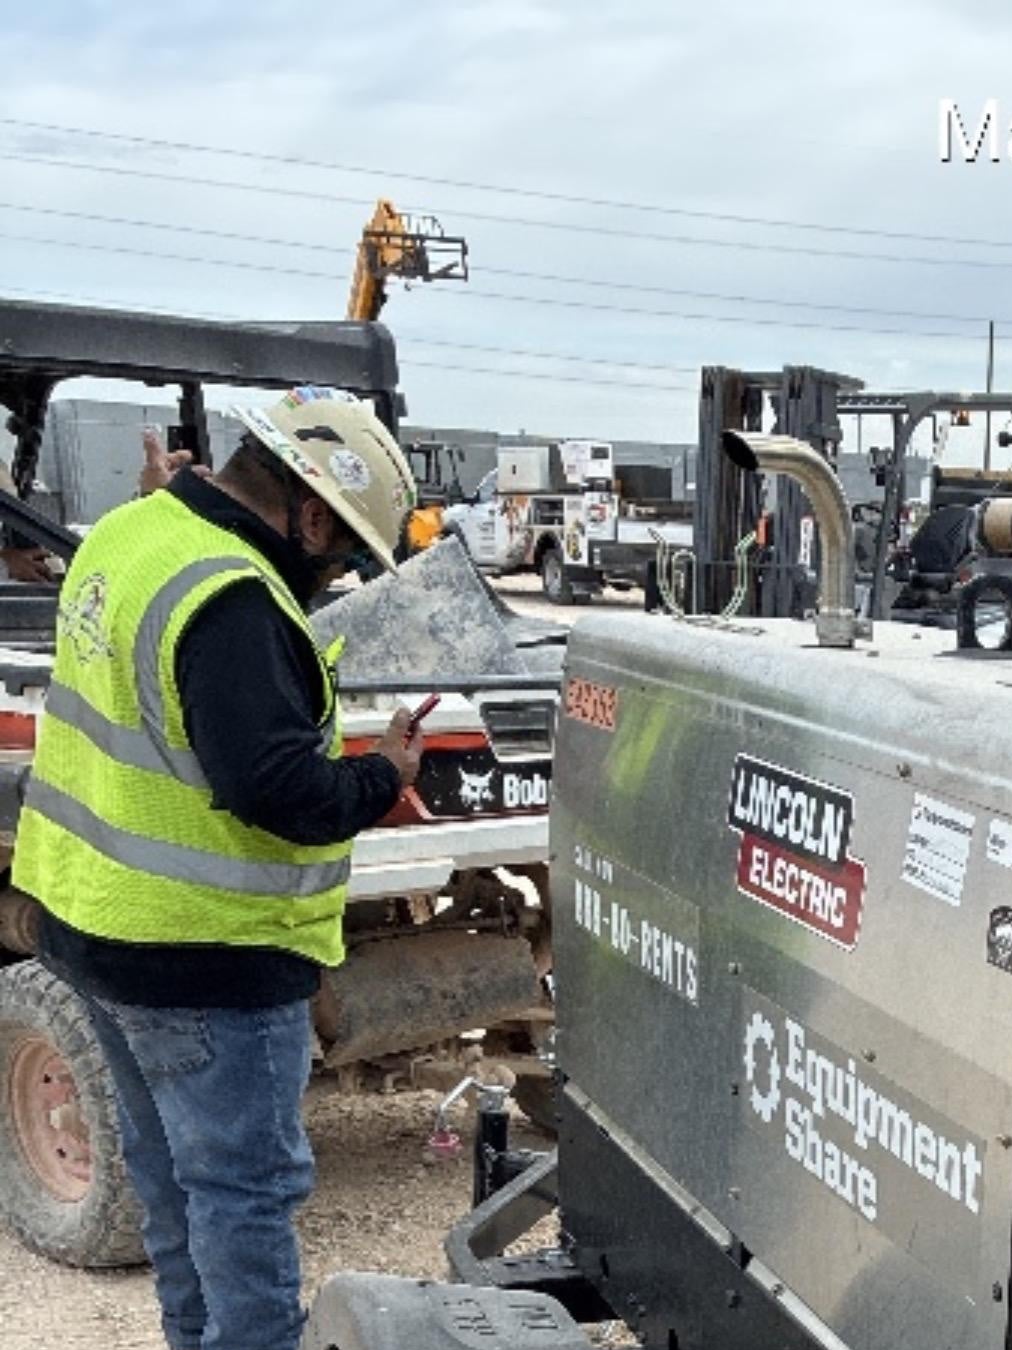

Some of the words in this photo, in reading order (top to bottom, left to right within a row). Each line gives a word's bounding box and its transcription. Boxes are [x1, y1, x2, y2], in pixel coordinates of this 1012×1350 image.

[503, 773, 553, 808] Bob
[733, 767, 844, 862] LINCOLN
[748, 846, 847, 928] ELECTRIC
[785, 1016, 983, 1216] Equipment
[785, 1096, 878, 1222] Share
